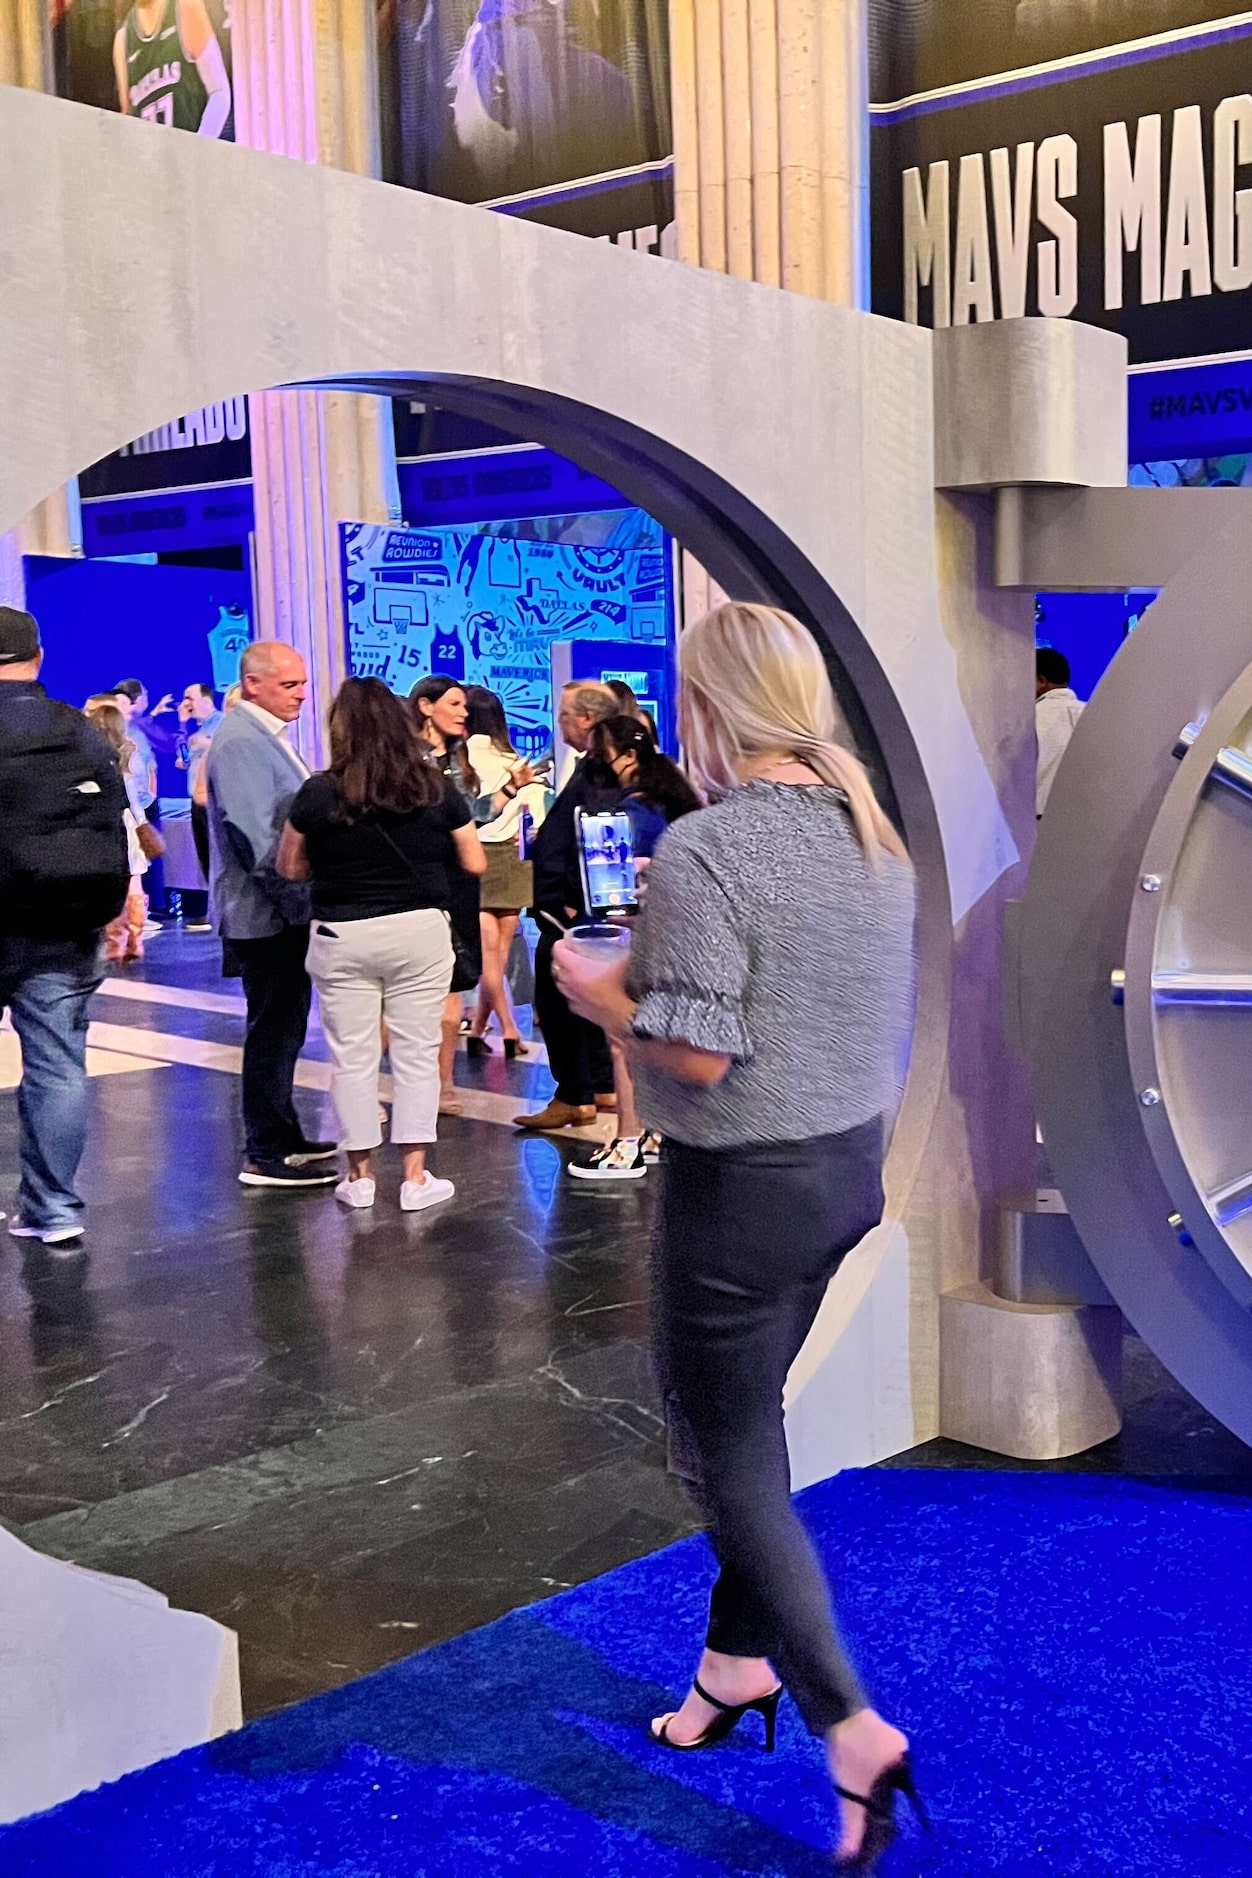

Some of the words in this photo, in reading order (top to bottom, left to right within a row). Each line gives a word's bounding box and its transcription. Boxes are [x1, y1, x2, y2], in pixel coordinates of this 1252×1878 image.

[902, 133, 1078, 328] MAVS
[572, 567, 627, 593] VAULT
[539, 599, 586, 611] DALLAS
[398, 645, 422, 667] 15
[438, 645, 457, 659] 22
